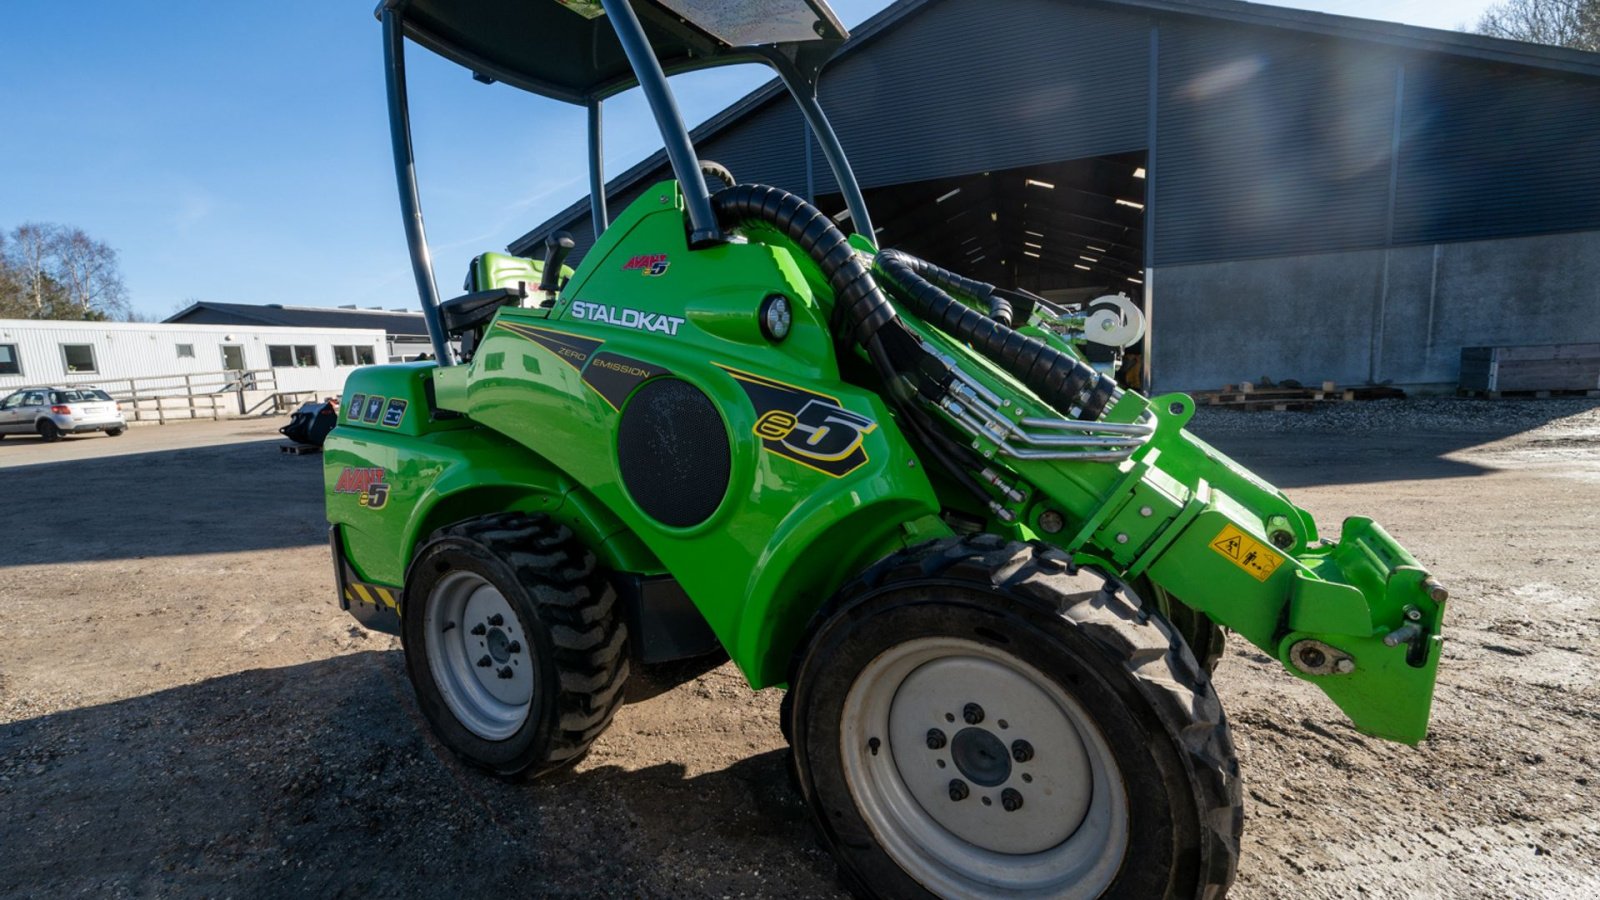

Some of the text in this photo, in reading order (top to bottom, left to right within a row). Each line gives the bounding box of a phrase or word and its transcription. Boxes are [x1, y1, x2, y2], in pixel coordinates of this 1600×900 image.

[621, 253, 668, 270] AVANT
[571, 300, 685, 336] STALDKAT
[558, 347, 651, 379] ZERO EMISSION
[752, 398, 878, 462] e5
[334, 466, 385, 494] AVANT
[359, 482, 391, 511] e5
